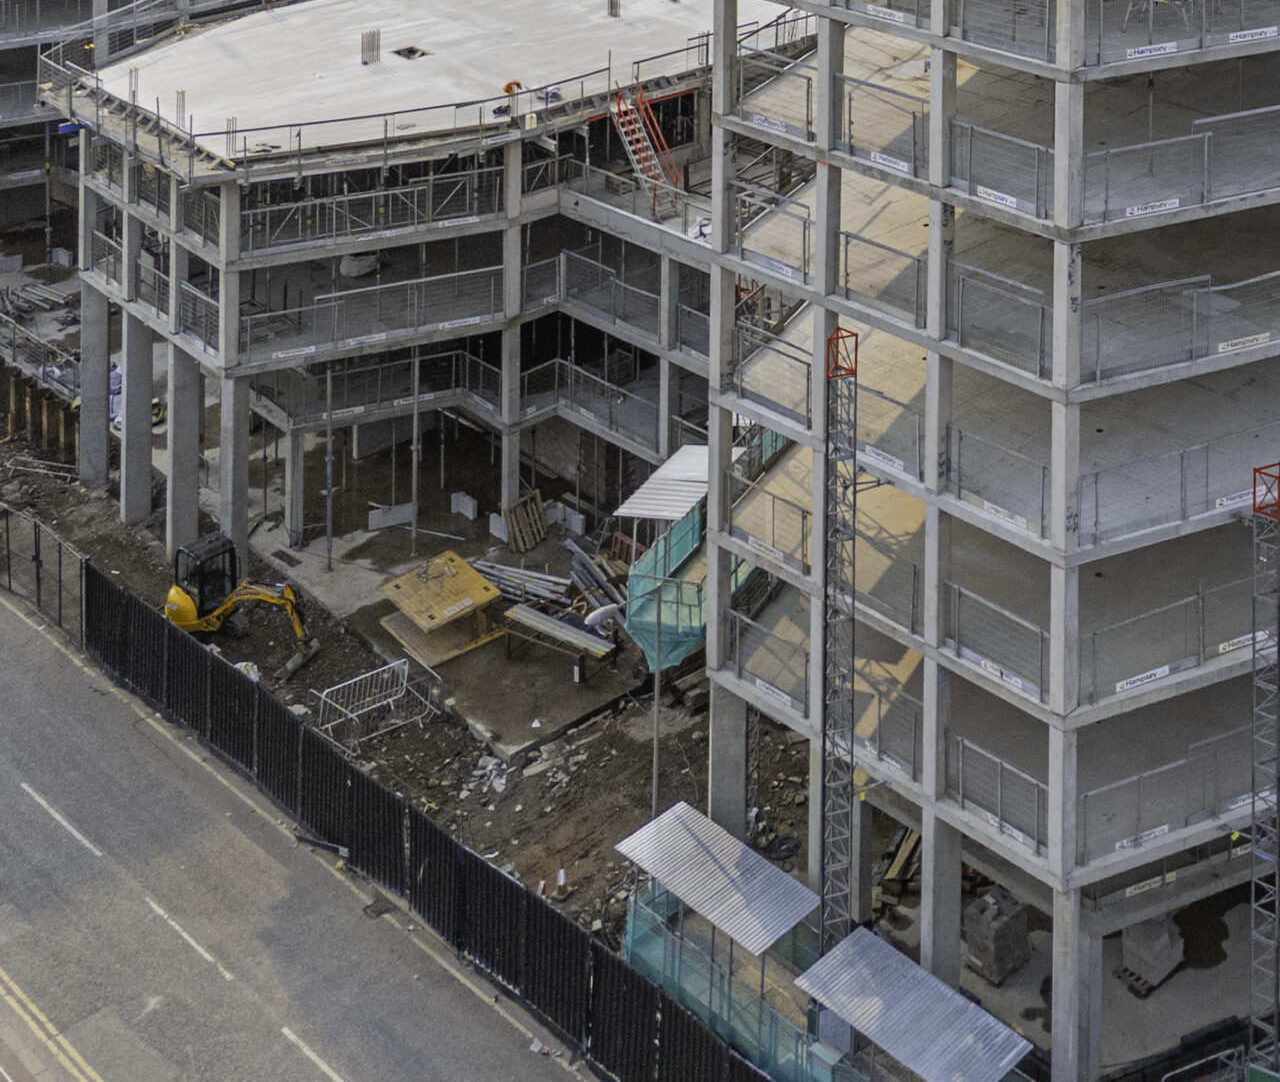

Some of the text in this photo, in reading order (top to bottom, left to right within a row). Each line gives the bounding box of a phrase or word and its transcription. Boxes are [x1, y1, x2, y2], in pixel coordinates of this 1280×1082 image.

[1236, 29, 1267, 40] Hampsey
[1134, 44, 1167, 56] Hampsey
[1126, 672, 1157, 687] Hampsey
